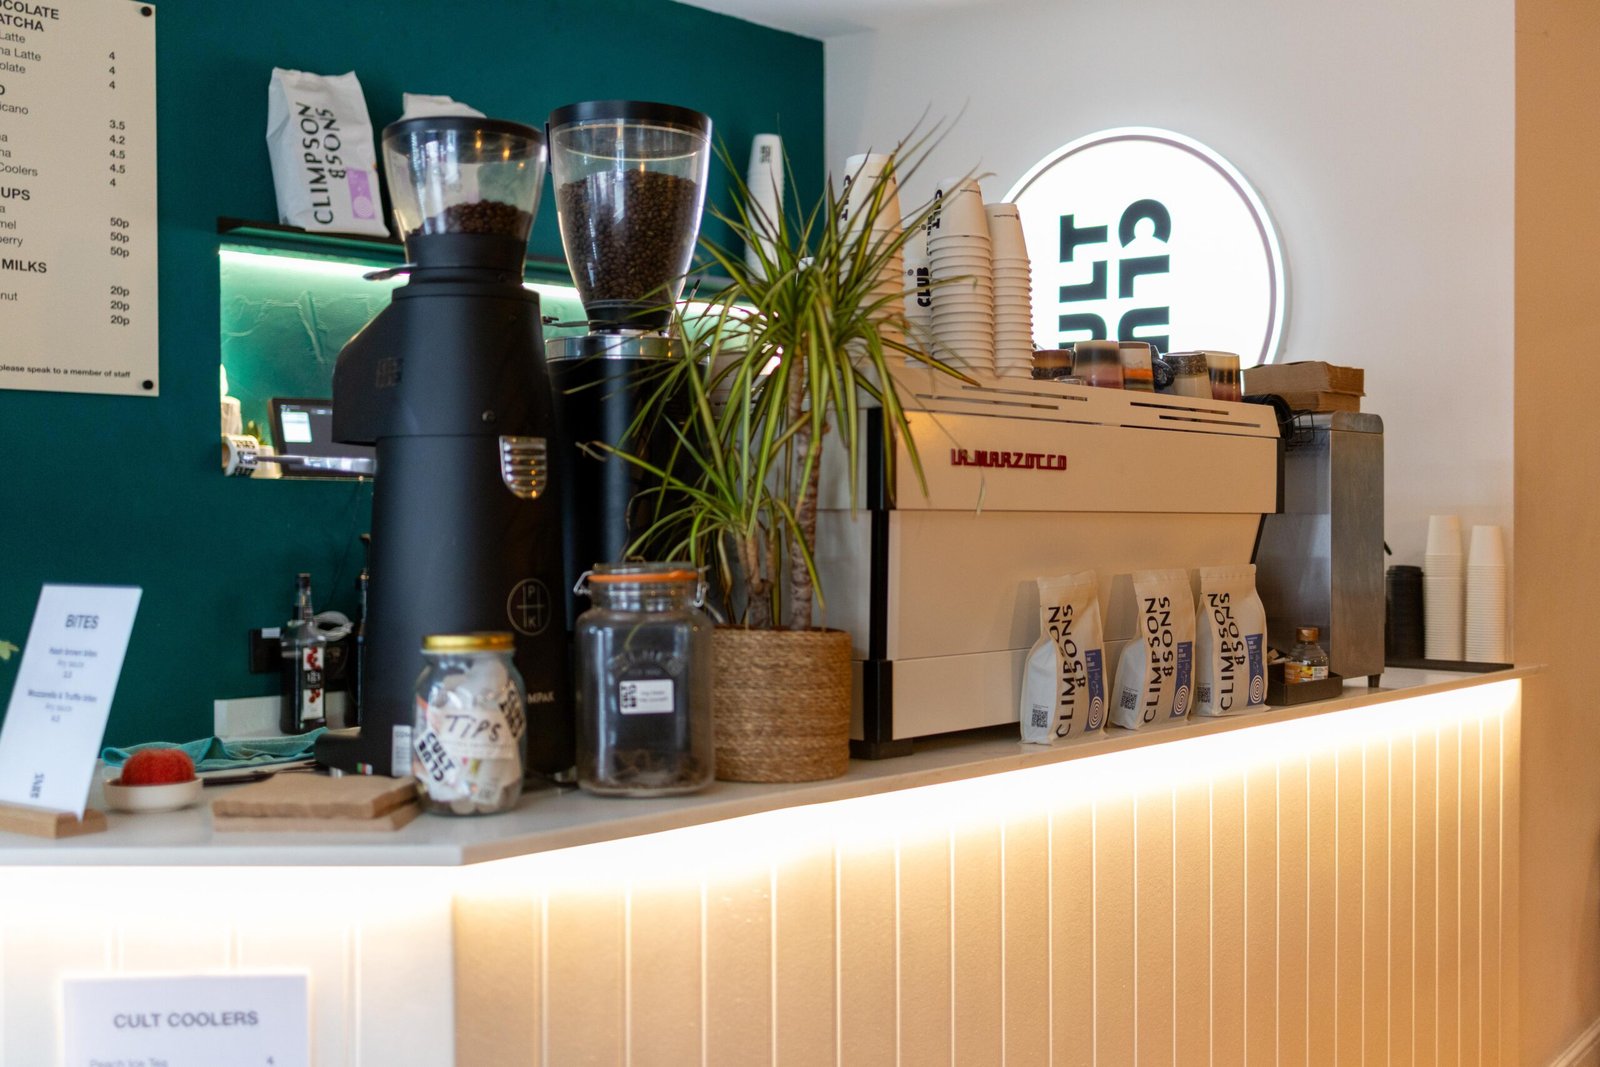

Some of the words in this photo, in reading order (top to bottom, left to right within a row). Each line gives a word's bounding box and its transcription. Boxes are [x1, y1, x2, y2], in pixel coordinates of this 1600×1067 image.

[0, 0, 59, 20] COLATE
[14, 48, 41, 61] Latte
[109, 51, 115, 60] 4
[109, 66, 115, 74] 4
[109, 80, 115, 89] 4
[109, 119, 126, 130] 3.5
[109, 135, 126, 145] 4.2
[109, 149, 126, 159] 4.5
[109, 163, 126, 174] 4.5
[295, 102, 334, 225] CLIMPSON
[109, 178, 116, 187] 4
[1, 187, 31, 200] UPS
[110, 217, 130, 228] 50p
[110, 232, 130, 243] 50p
[110, 246, 130, 258] 50p
[2, 258, 47, 273] MILKS
[1059, 214, 1108, 349] ULT
[1118, 199, 1171, 353] CLU
[110, 286, 130, 297] 20p
[110, 300, 130, 312] 20p
[110, 315, 130, 326] 20p
[27, 366, 50, 375] speak
[70, 368, 102, 376] member
[65, 613, 99, 629] BITES
[1207, 593, 1234, 711] CLIMPSON
[1143, 598, 1162, 723] CLIMPSON
[1048, 606, 1076, 738] CLIMPON
[113, 1013, 162, 1029] CULT
[167, 1010, 259, 1027] COOLERS
